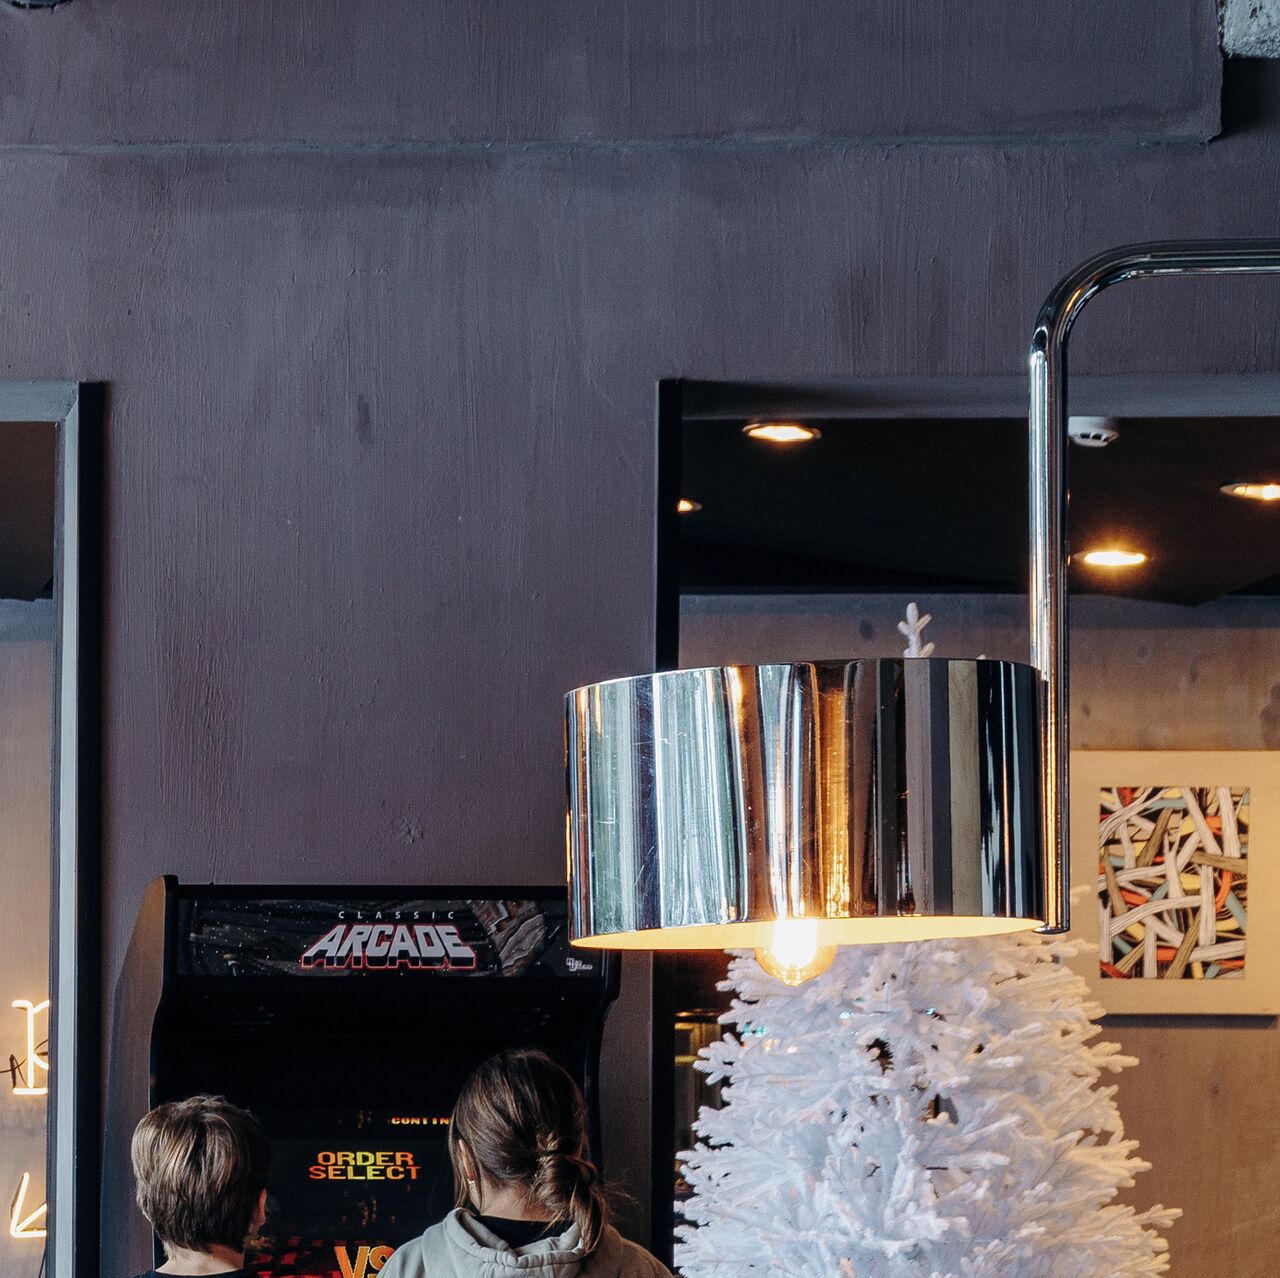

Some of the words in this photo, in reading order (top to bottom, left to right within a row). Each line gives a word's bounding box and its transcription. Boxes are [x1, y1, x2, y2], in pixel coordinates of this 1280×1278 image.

[338, 911, 454, 920] CLASSIC
[301, 924, 476, 968] ARCADE
[317, 1151, 414, 1166] ORDER
[308, 1165, 421, 1180] SELECT
